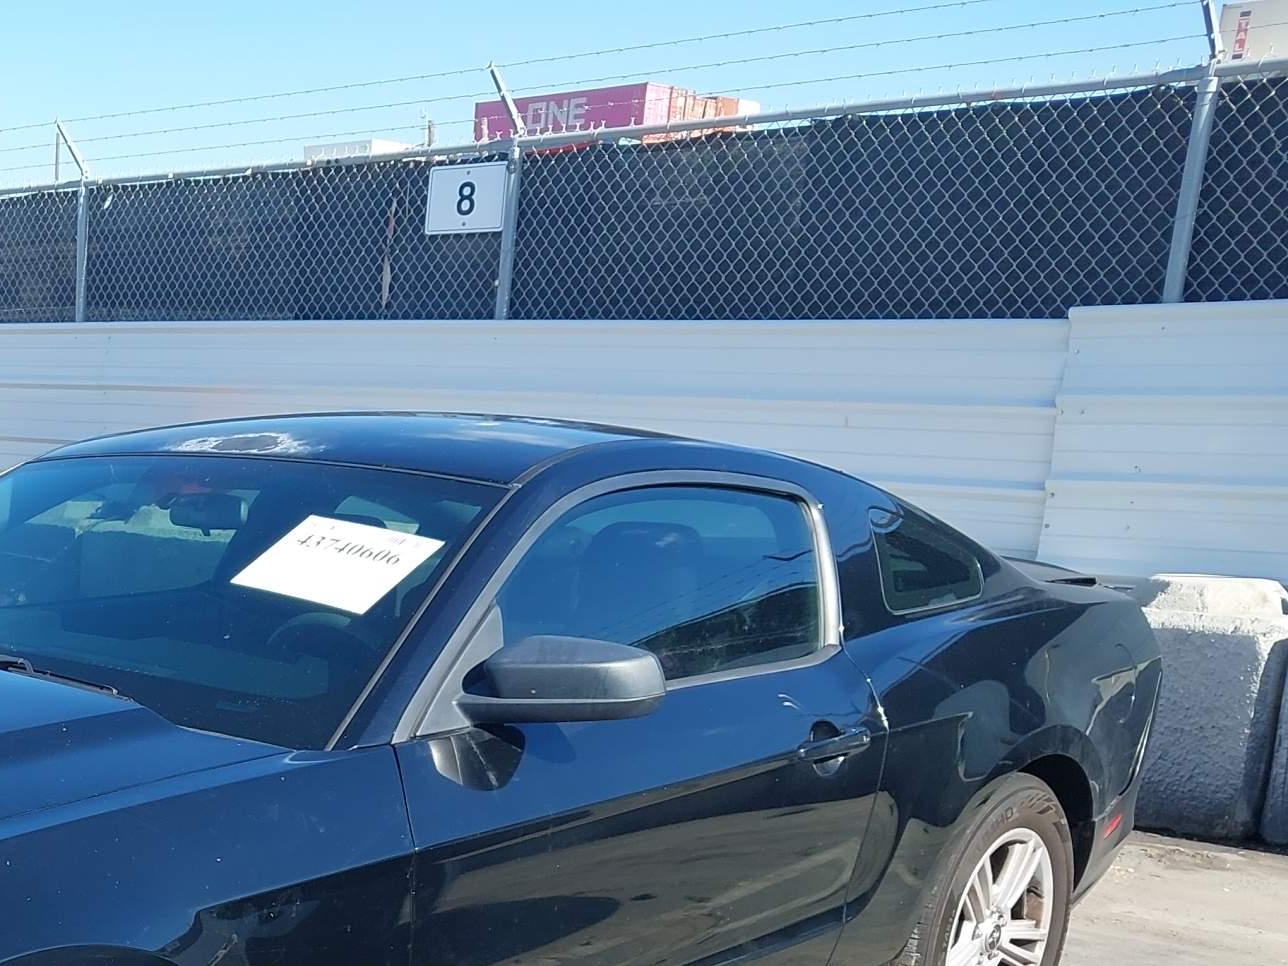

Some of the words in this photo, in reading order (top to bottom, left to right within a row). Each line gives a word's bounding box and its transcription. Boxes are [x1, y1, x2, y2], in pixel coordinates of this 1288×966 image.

[526, 96, 588, 130] ONE
[455, 181, 476, 216] 8
[297, 534, 400, 565] 43740606
